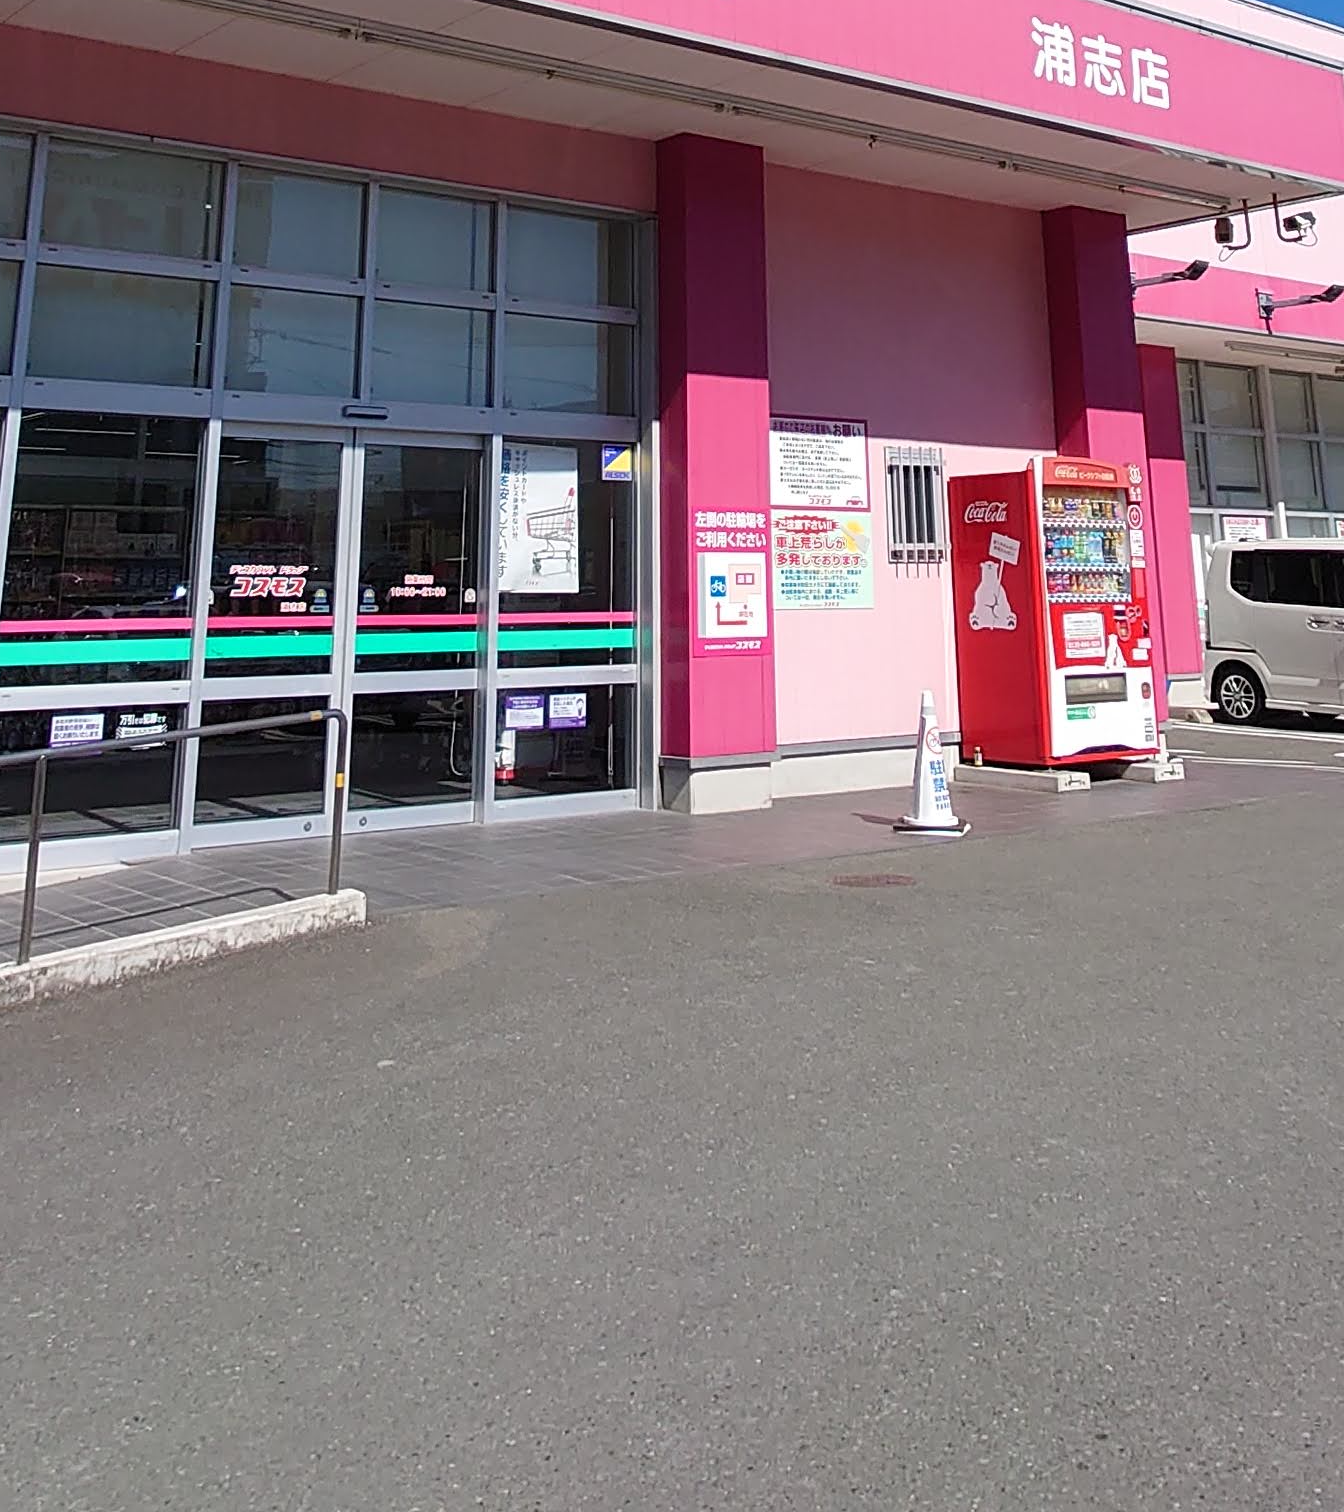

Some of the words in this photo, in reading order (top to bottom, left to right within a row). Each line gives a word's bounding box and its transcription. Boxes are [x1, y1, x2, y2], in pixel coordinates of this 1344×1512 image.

[1031, 16, 1170, 110] 浦志店
[696, 531, 767, 548] ご利用ください
[229, 576, 307, 597] コスモス
